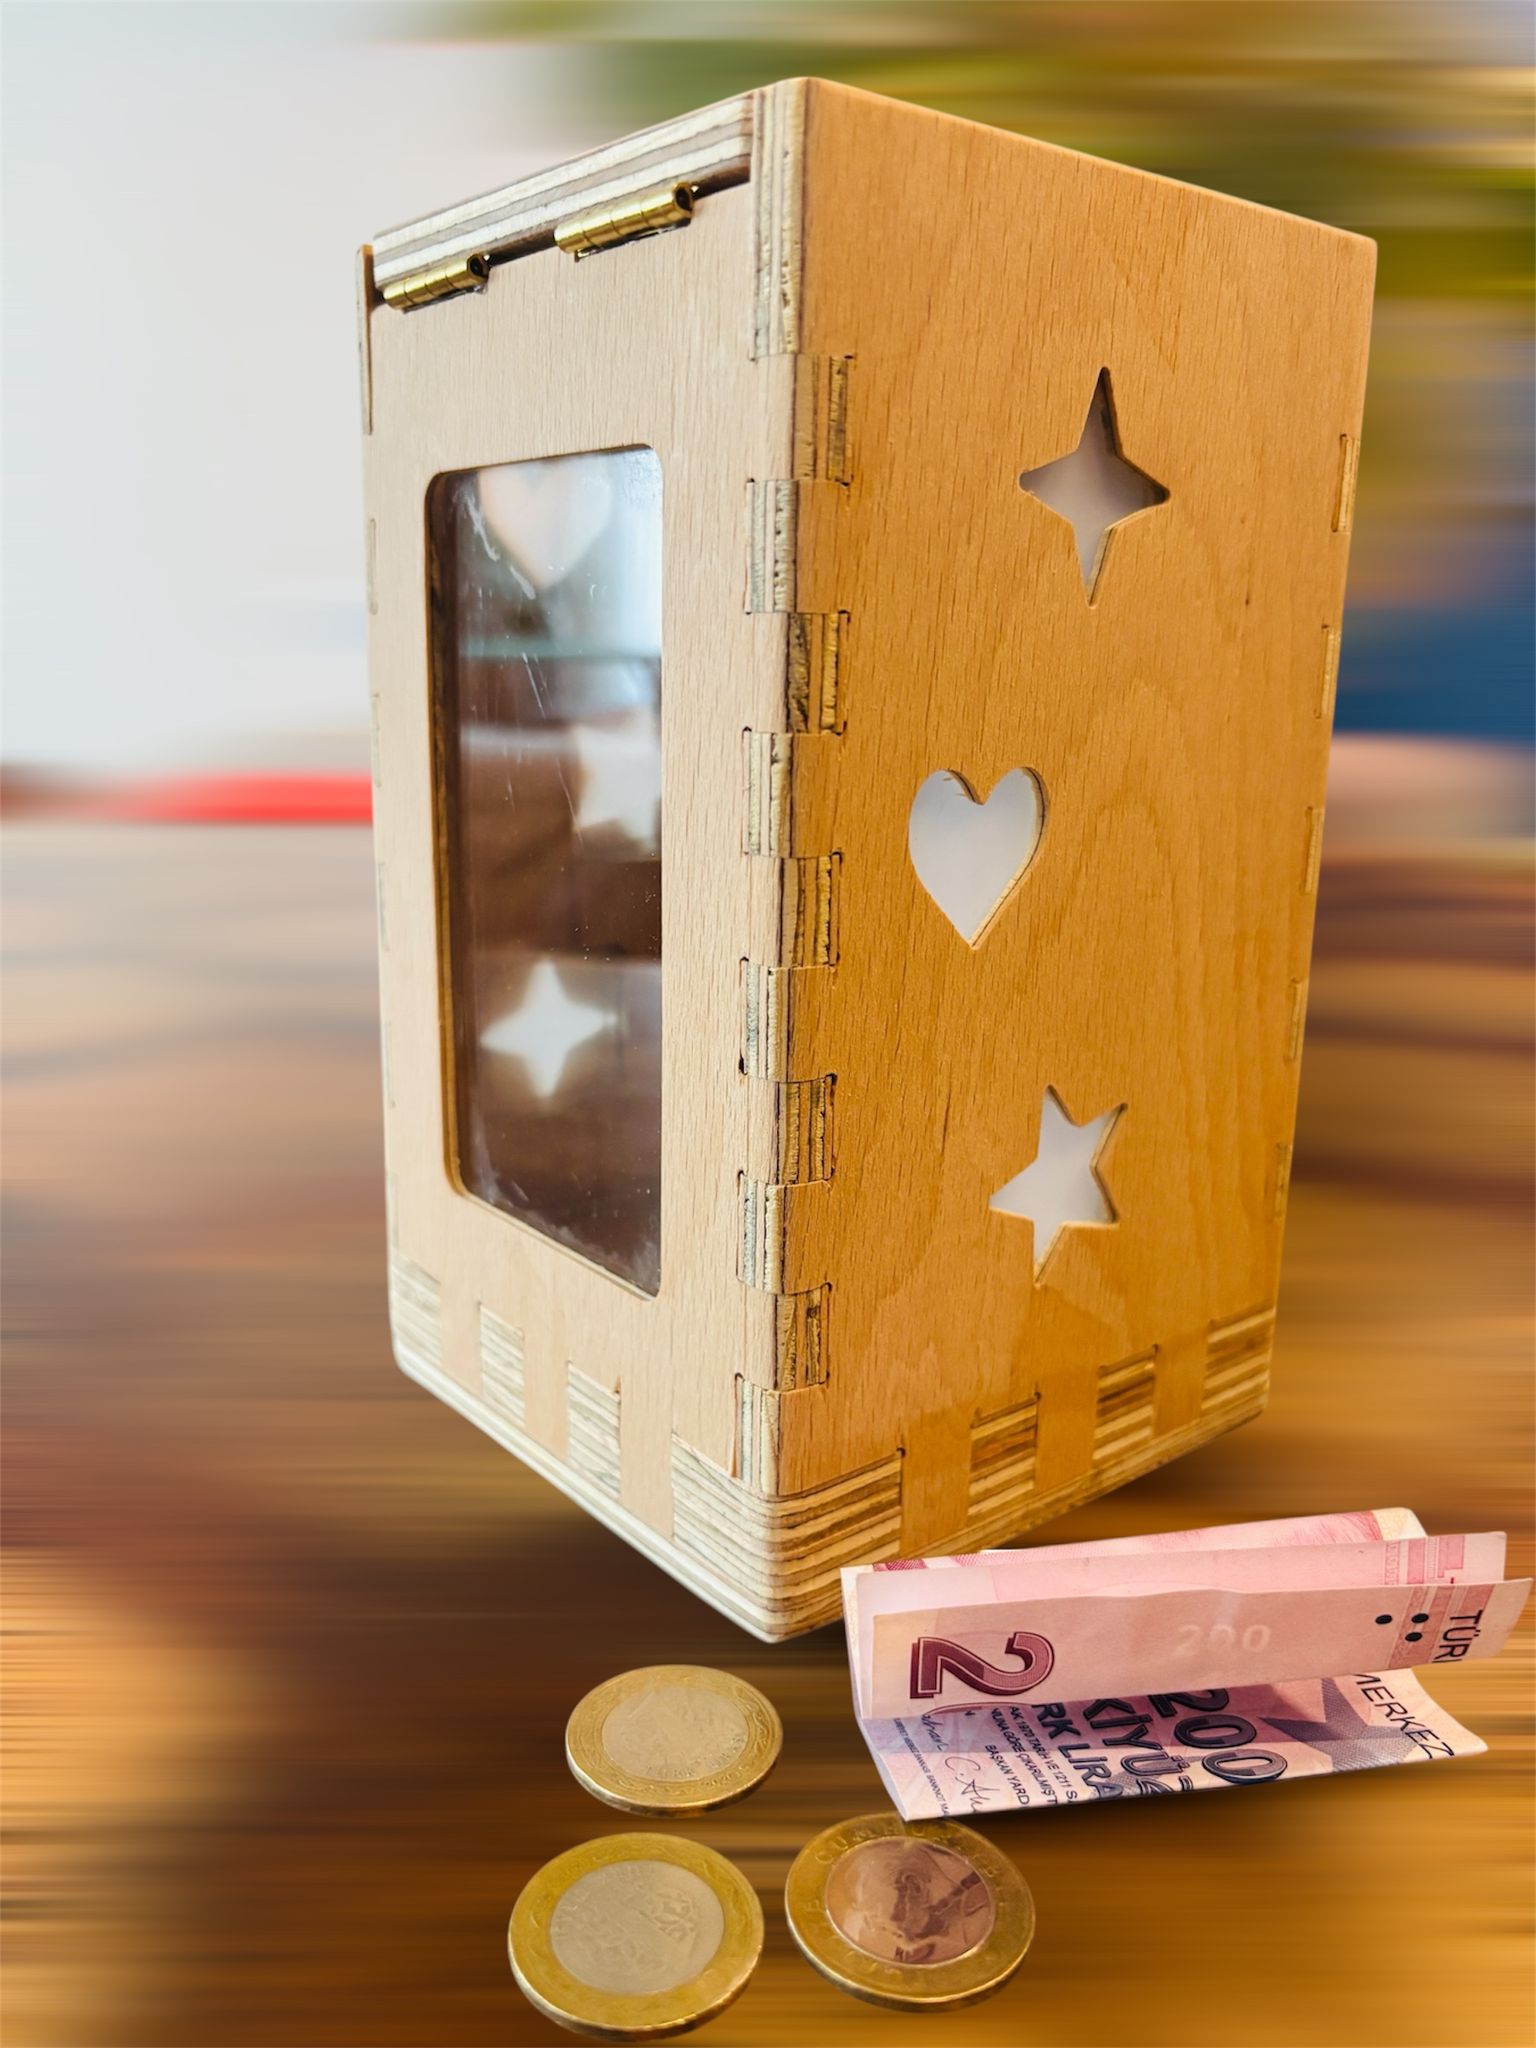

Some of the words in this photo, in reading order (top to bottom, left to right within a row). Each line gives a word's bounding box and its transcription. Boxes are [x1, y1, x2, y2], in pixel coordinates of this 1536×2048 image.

[1175, 1623, 1273, 1656] 200
[910, 1631, 1055, 1701] 2
[1147, 1688, 1288, 1784] 200
[985, 1744, 1014, 1775] BAŞKAN
[1044, 1759, 1060, 1771] VE
[1053, 1770, 1073, 1789] 1211
[1066, 1790, 1078, 1803] S
